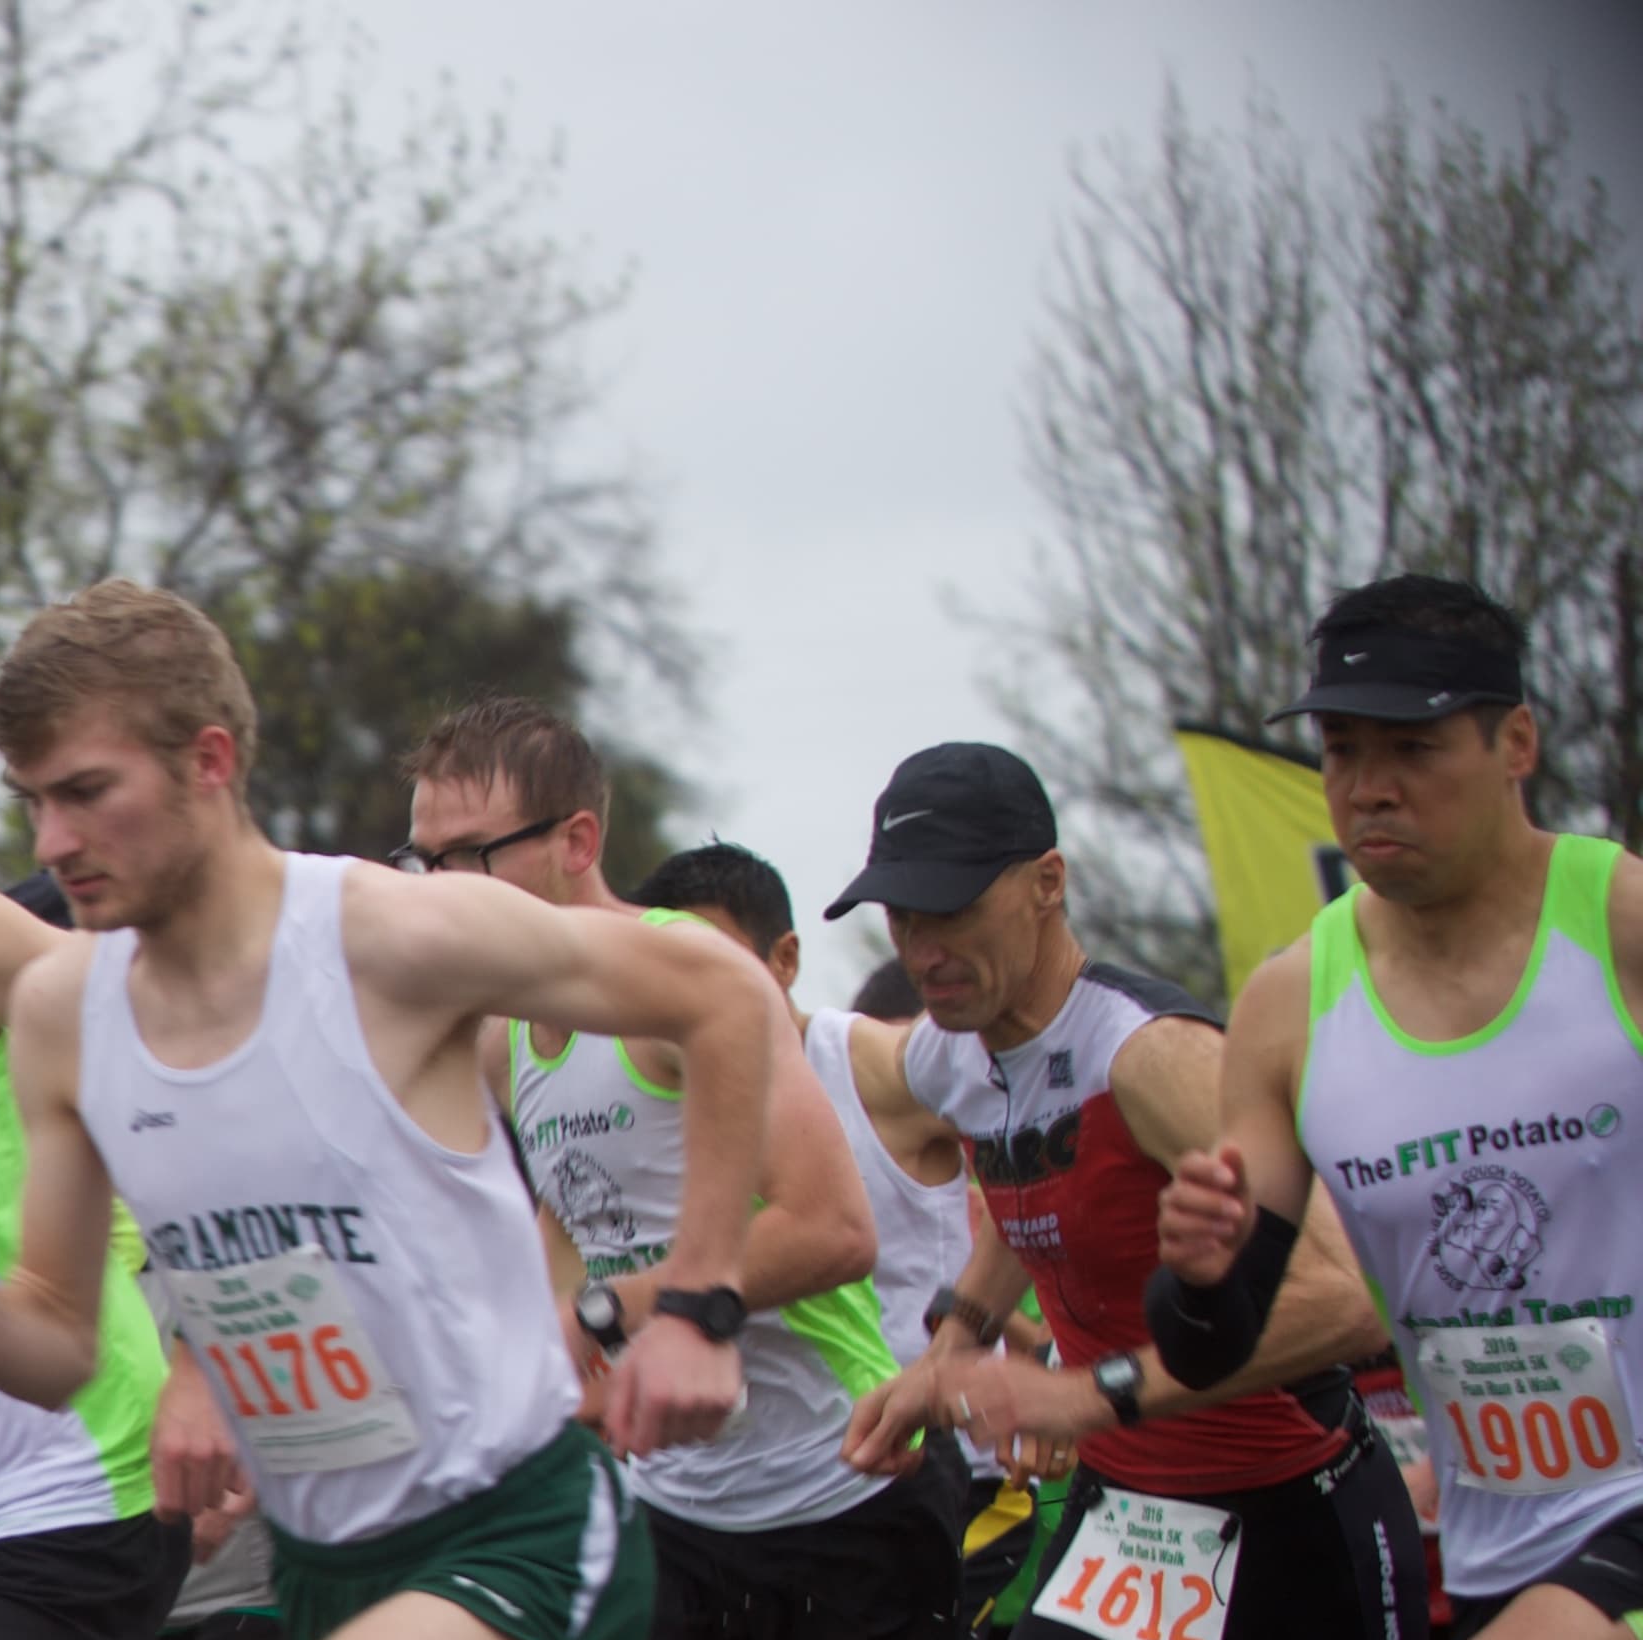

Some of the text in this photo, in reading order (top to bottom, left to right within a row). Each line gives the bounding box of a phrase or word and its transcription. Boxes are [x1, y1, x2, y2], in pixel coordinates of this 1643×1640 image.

[1335, 1112, 1583, 1190] The FIT Potato
[1462, 1165, 1506, 1181] COUCH
[1520, 1294, 1633, 1325] Team
[1483, 1336, 1517, 1354] 2016
[208, 1324, 372, 1417] 1176
[1528, 1355, 1549, 1371] 5K
[1527, 1375, 1562, 1392] Walk
[1445, 1395, 1621, 1480] 1900
[1142, 1503, 1164, 1523] 2016
[1166, 1527, 1183, 1546] 5K
[1118, 1540, 1135, 1557] Fun
[1158, 1548, 1186, 1568] Walk
